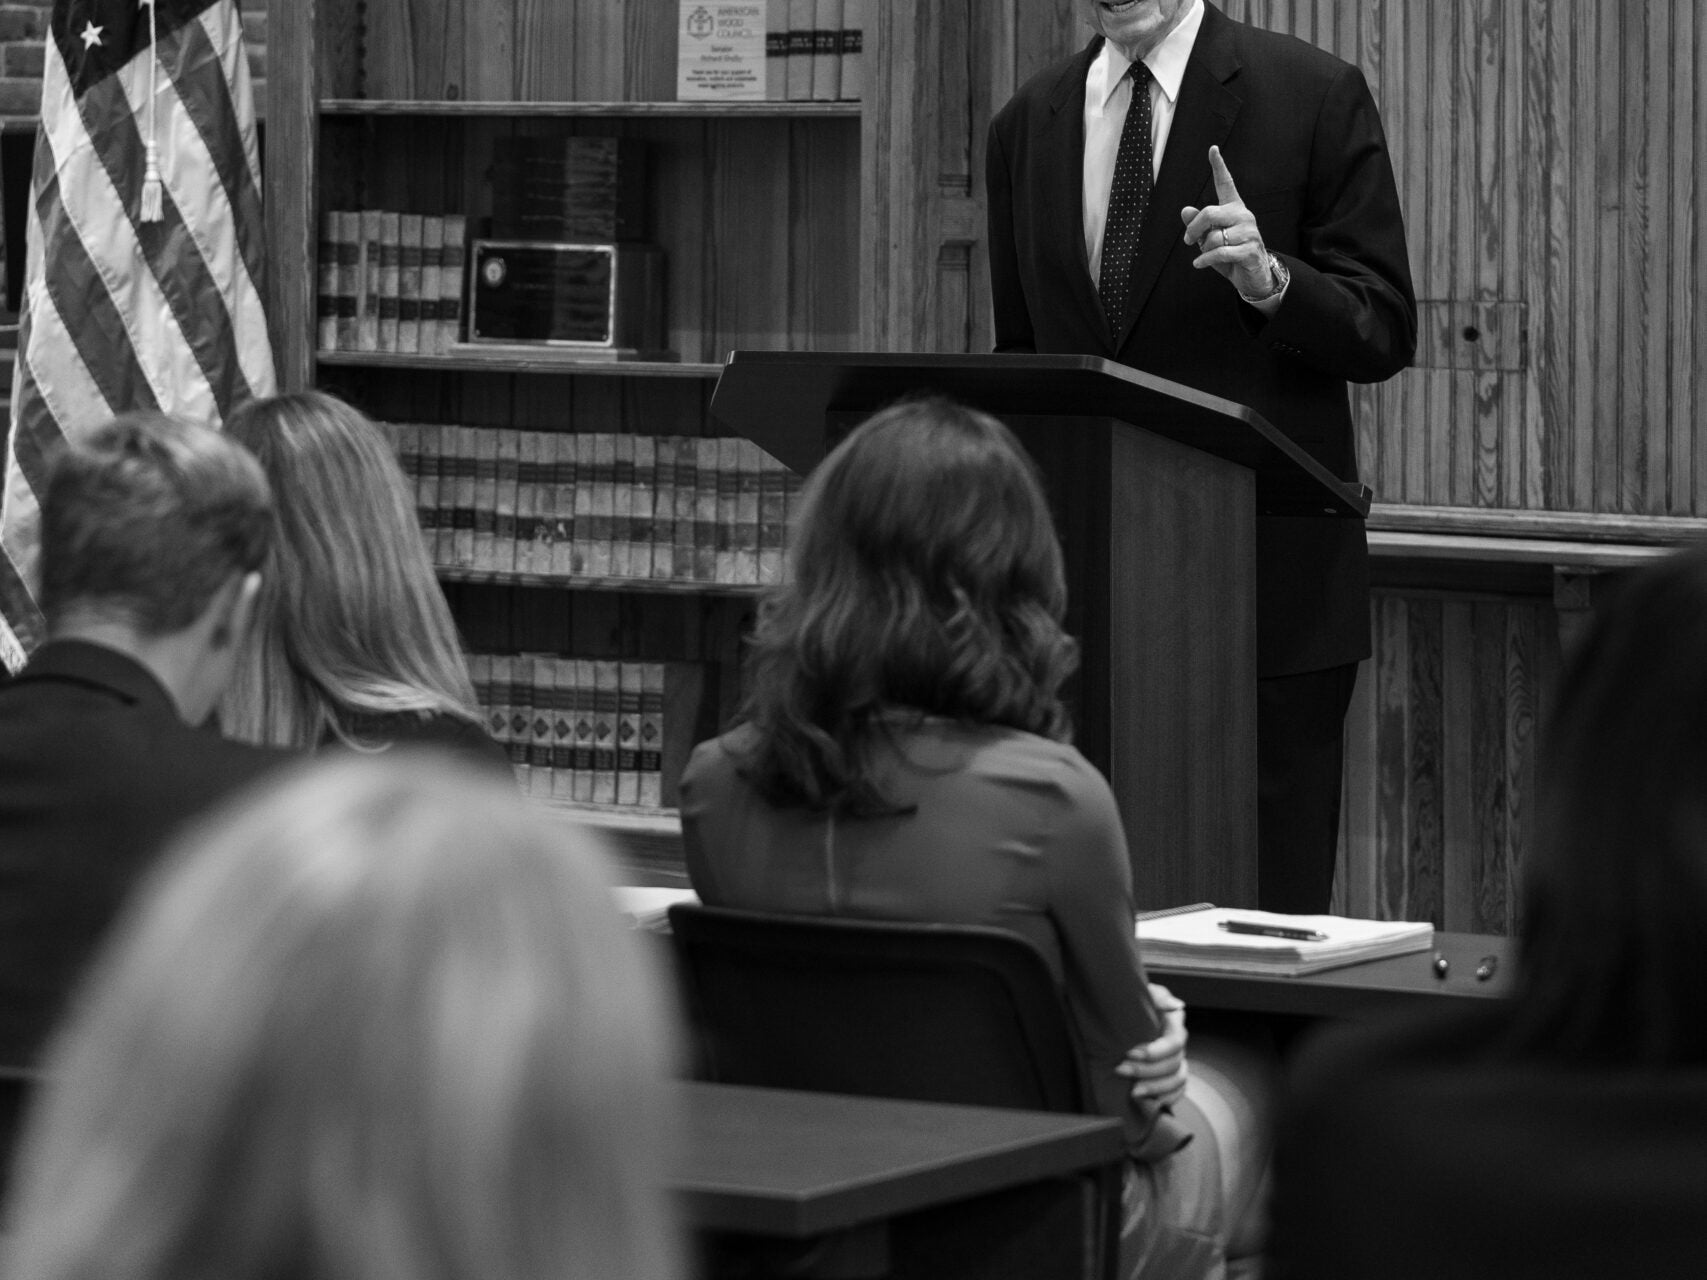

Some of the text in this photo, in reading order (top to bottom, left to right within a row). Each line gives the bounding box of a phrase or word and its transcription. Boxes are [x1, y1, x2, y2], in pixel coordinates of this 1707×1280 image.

[718, 6, 760, 17] AMERICAN
[718, 19, 744, 27] WOOD
[716, 29, 754, 39] COUNCIL
